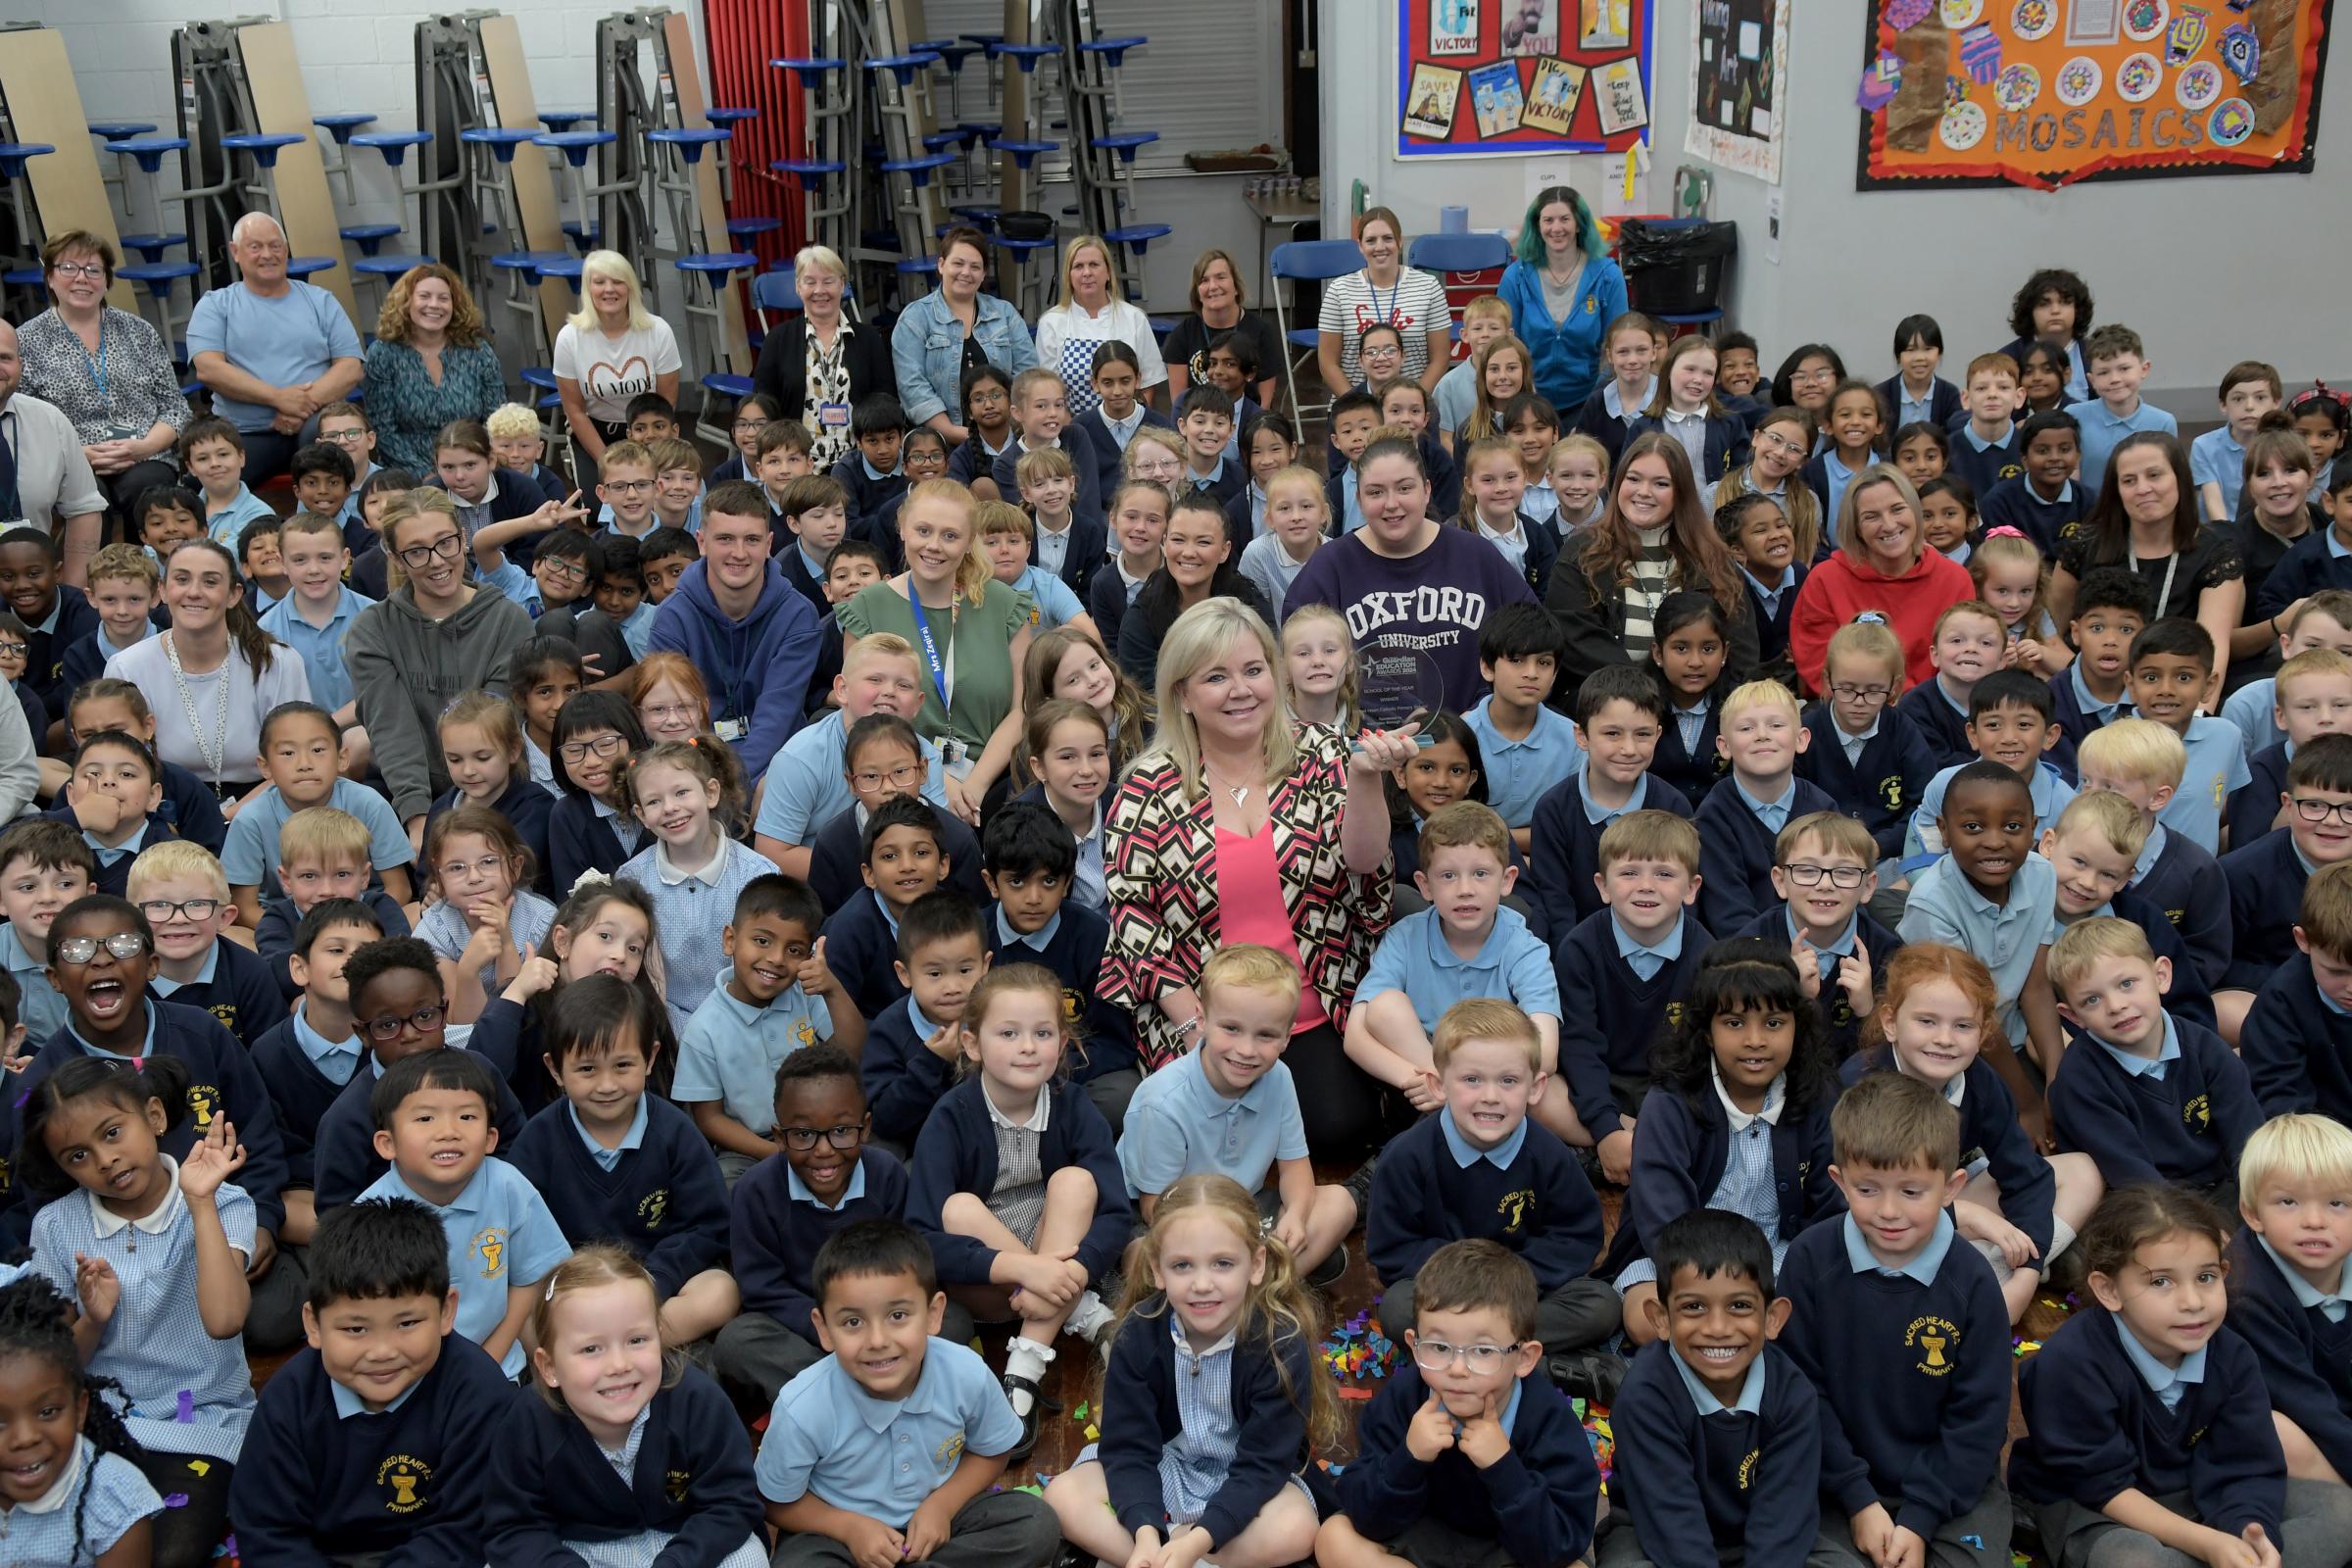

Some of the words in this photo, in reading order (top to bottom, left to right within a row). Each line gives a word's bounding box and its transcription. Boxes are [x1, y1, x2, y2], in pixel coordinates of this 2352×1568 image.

[1993, 108, 2205, 153] MOSAICS
[1346, 585, 1486, 640] OXFORD
[1378, 629, 1460, 651] UNIVERSITY
[1375, 662, 1417, 670] EDUCATION
[1904, 1316, 1927, 1347] SACRED
[1926, 1315, 1957, 1333] HEART
[1916, 1360, 1955, 1377] PRIMARY
[376, 1454, 398, 1486] SACRED
[398, 1453, 428, 1471] HEART
[1739, 1454, 1755, 1490] SACRED
[385, 1496, 428, 1514] PRIMARY
